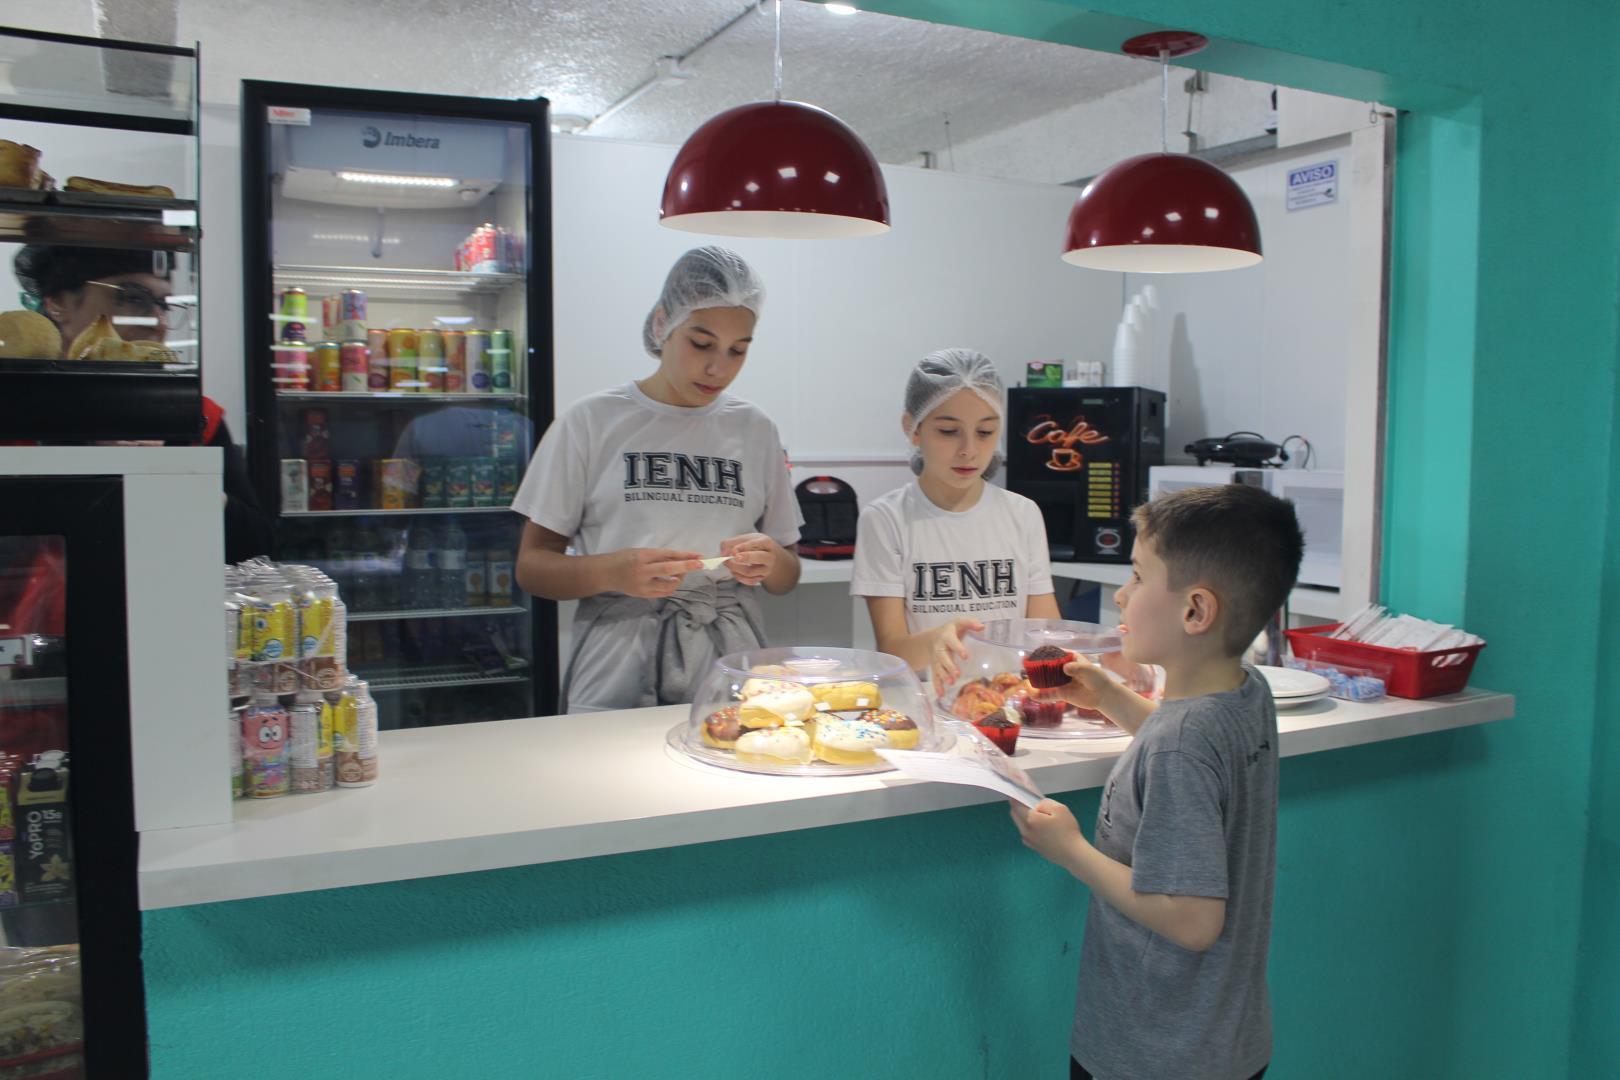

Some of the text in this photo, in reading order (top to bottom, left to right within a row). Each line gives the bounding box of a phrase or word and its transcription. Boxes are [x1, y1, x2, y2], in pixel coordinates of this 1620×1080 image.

[383, 131, 441, 149] Imbera
[1291, 165, 1333, 186] AVISO
[623, 452, 745, 497] IENH
[623, 491, 745, 508] BILINGUAL EDUCATION
[912, 558, 1017, 601] IENH
[912, 603, 967, 614] BILINGUAL
